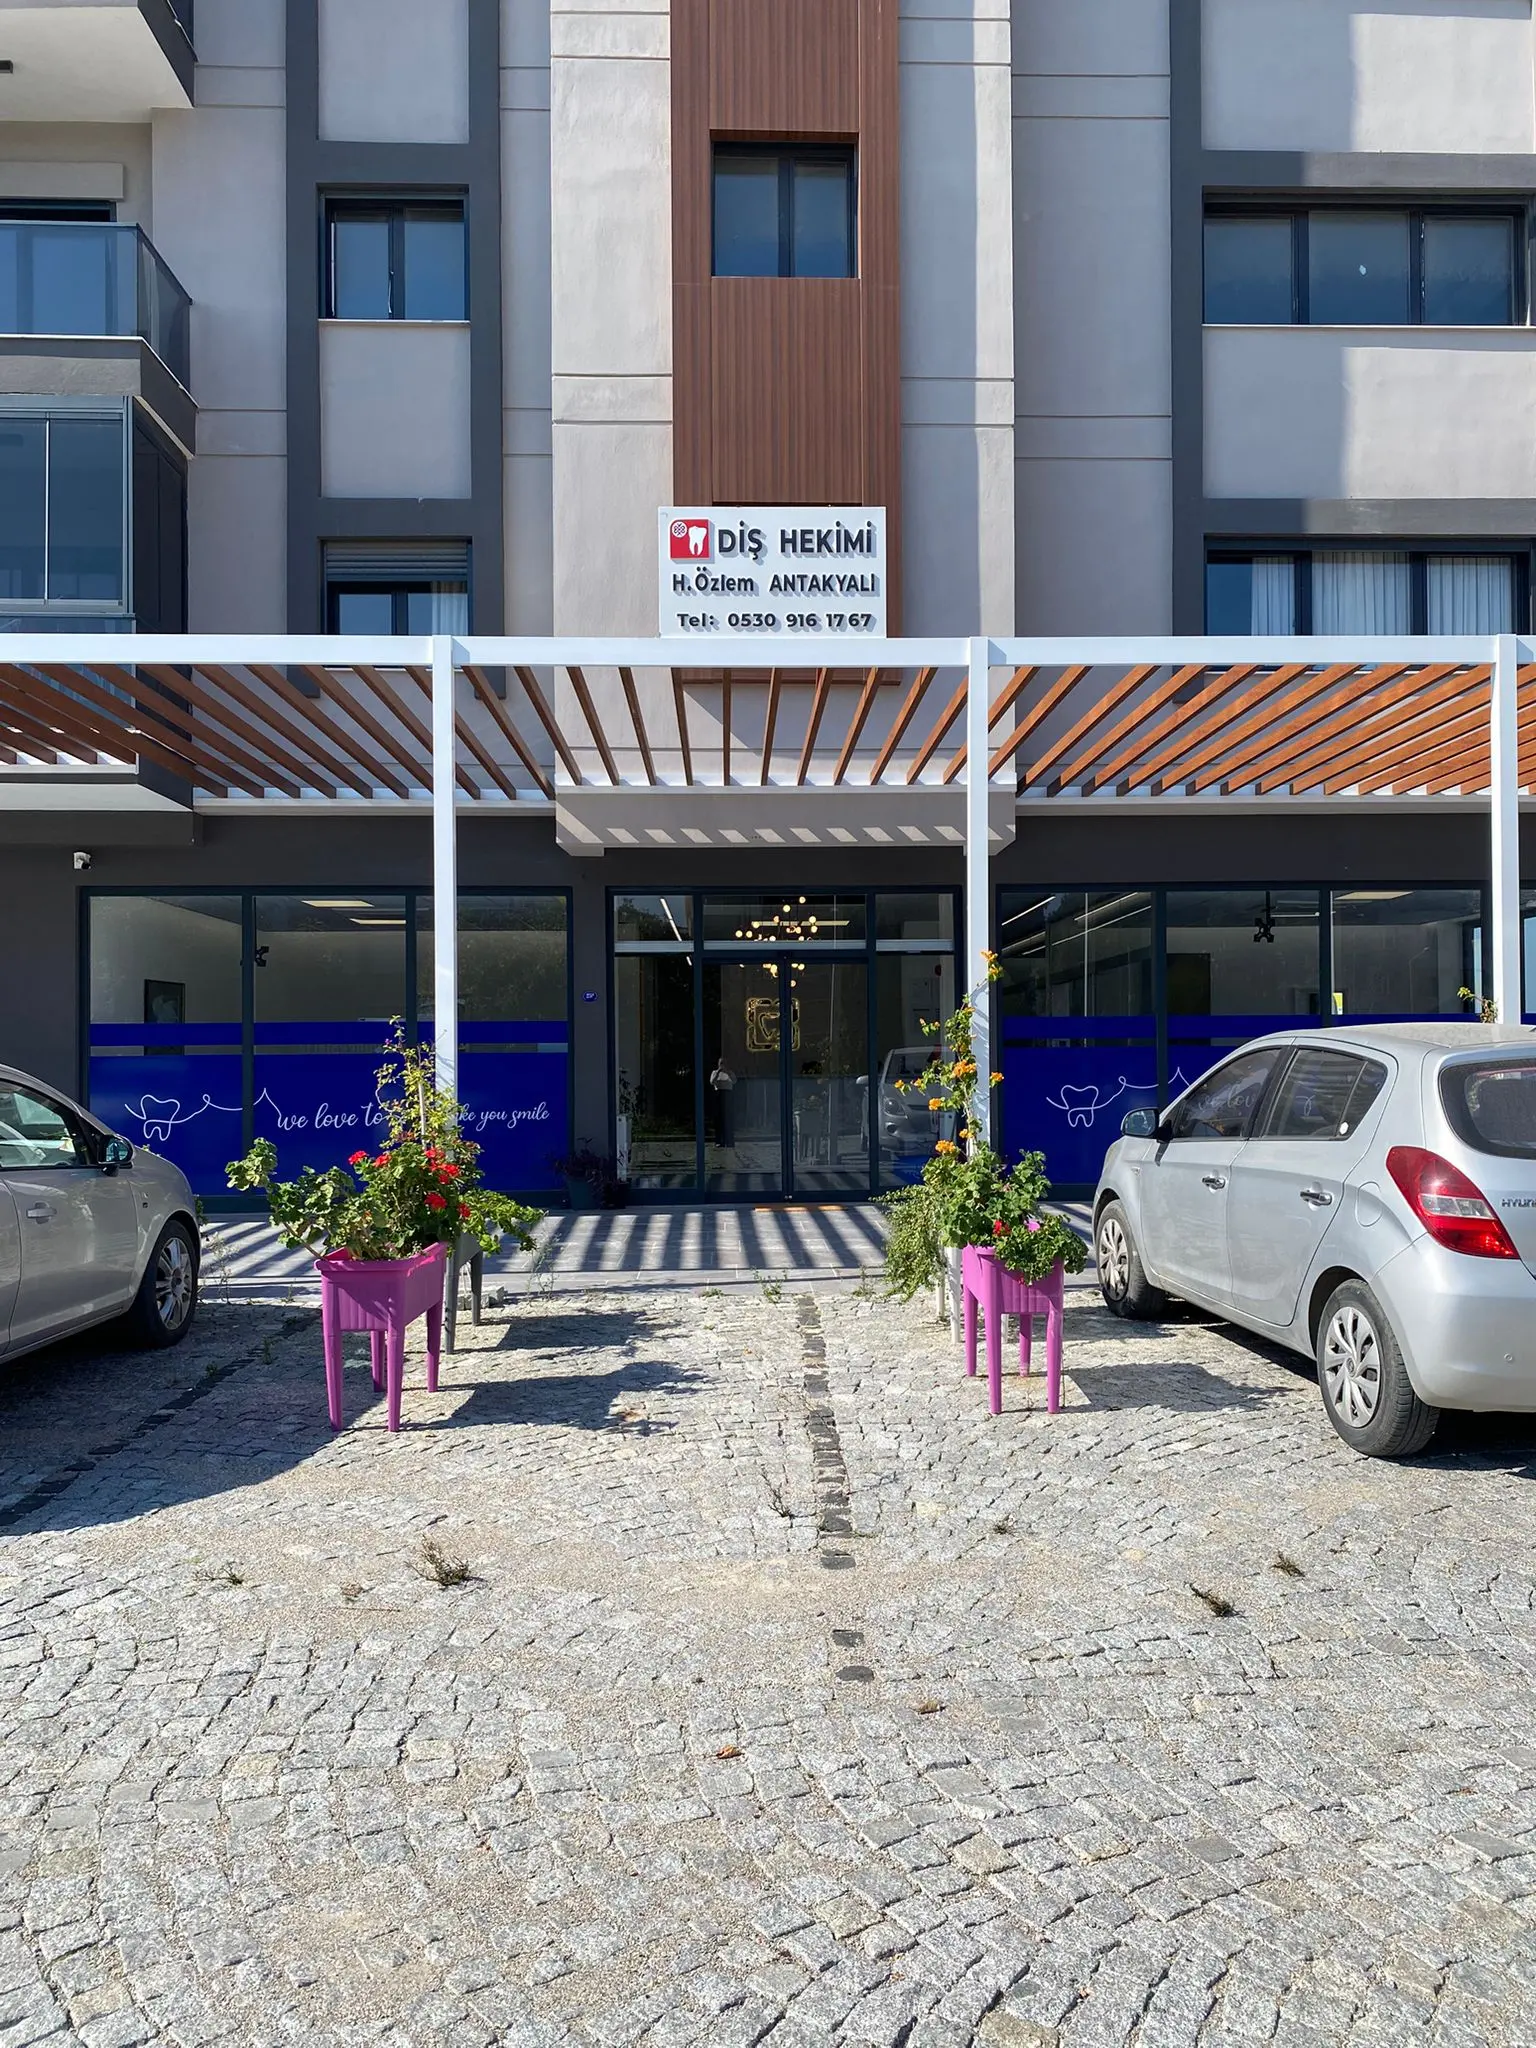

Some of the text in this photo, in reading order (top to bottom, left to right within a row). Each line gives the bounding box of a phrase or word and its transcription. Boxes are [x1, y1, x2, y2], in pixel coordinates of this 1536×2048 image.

[718, 521, 873, 560] DİŞ HEKİMİ
[769, 573, 875, 592] ANTAKYALI
[677, 613, 872, 627] Tel: 0530 916 1767
[277, 1113, 308, 1130] we
[315, 1103, 358, 1129] love
[361, 1102, 384, 1127] to
[476, 1110, 507, 1131] you
[507, 1101, 550, 1128] smile
